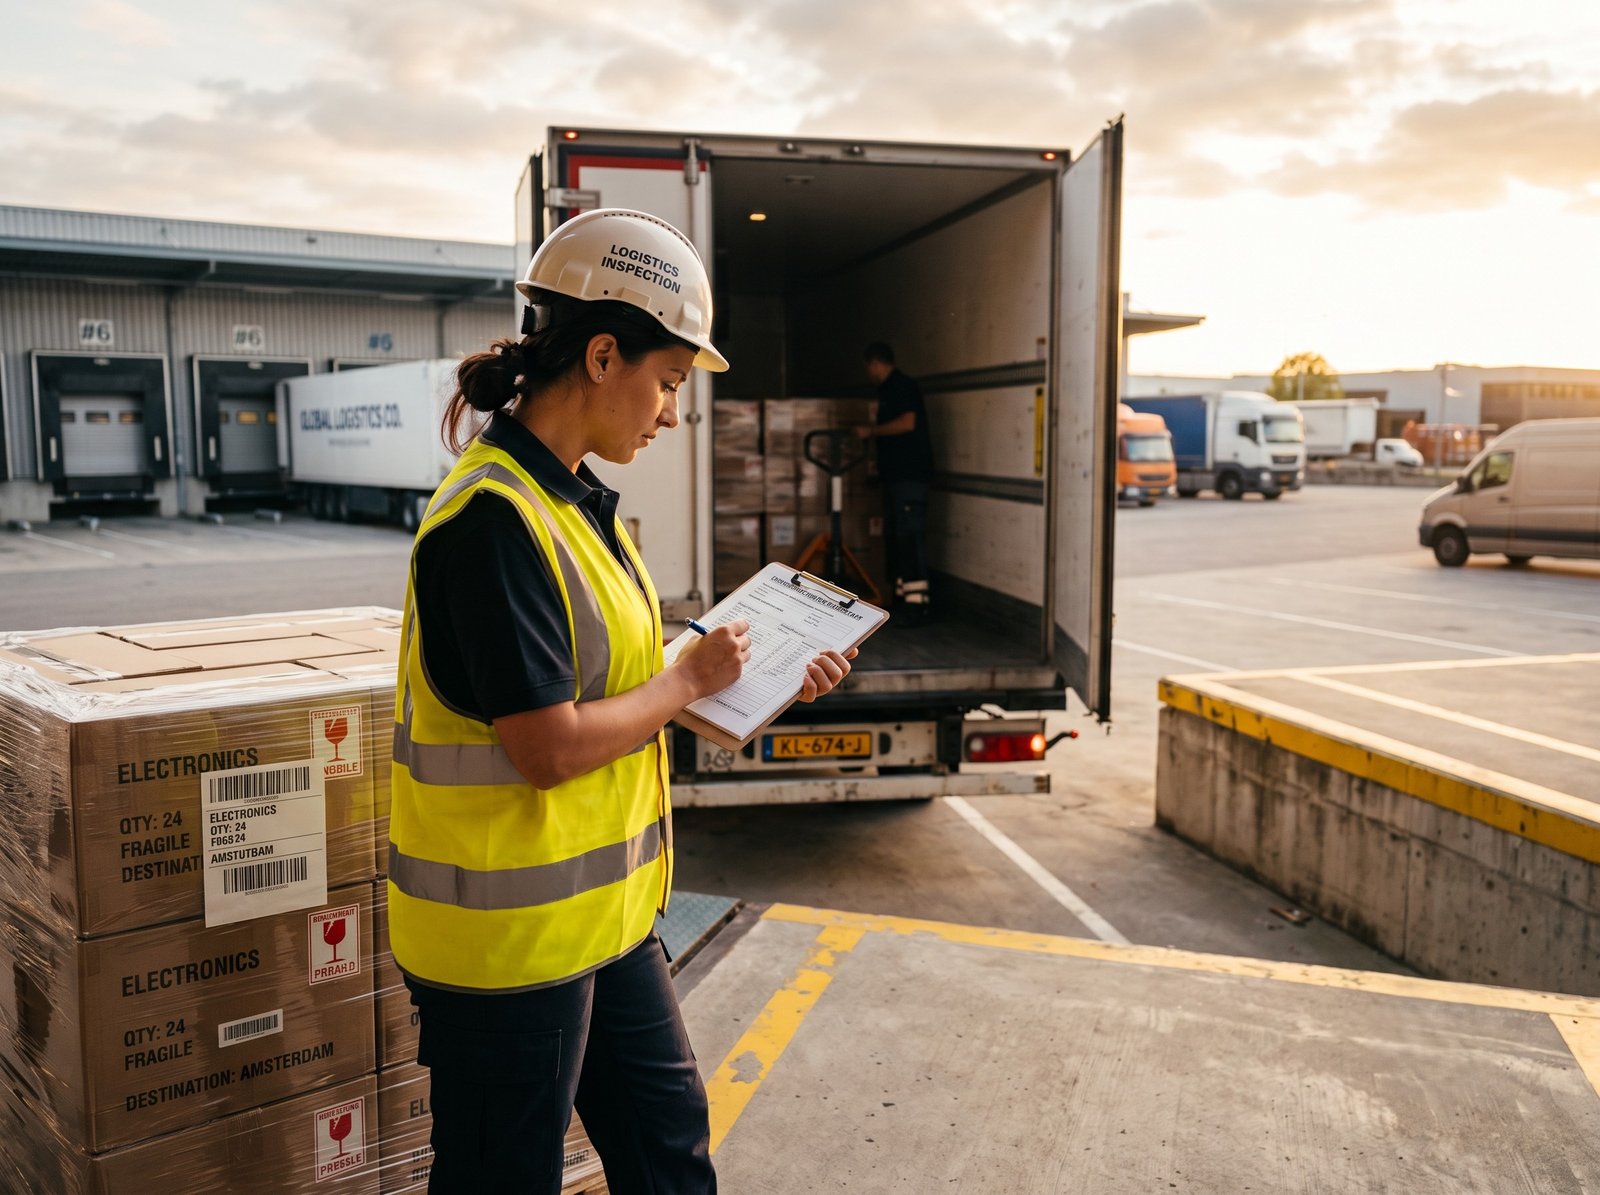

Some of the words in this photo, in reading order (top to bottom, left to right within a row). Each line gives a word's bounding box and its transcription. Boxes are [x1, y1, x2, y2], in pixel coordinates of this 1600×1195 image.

[610, 244, 680, 278] LOGISTICS
[601, 256, 681, 294] INSPECTION
[81, 322, 111, 342] #6
[334, 404, 382, 430] LOGISTICS
[781, 738, 862, 754] KL-674-J
[118, 747, 259, 784] ELECTRONICS
[120, 814, 157, 835] QTY:
[163, 810, 182, 828] 24
[210, 804, 276, 823] ELECTRONICS
[235, 822, 246, 831] 24
[121, 833, 190, 859] FRAGILE
[211, 845, 274, 864] AMSTUTBAM
[122, 949, 260, 997] ELECTRONICS
[124, 1025, 161, 1047] QTY:
[166, 1018, 186, 1037] 24
[125, 1040, 193, 1071] FRAGILE
[126, 1070, 236, 1112] DESTINATION:
[240, 1041, 334, 1081] AMSTERDAM
